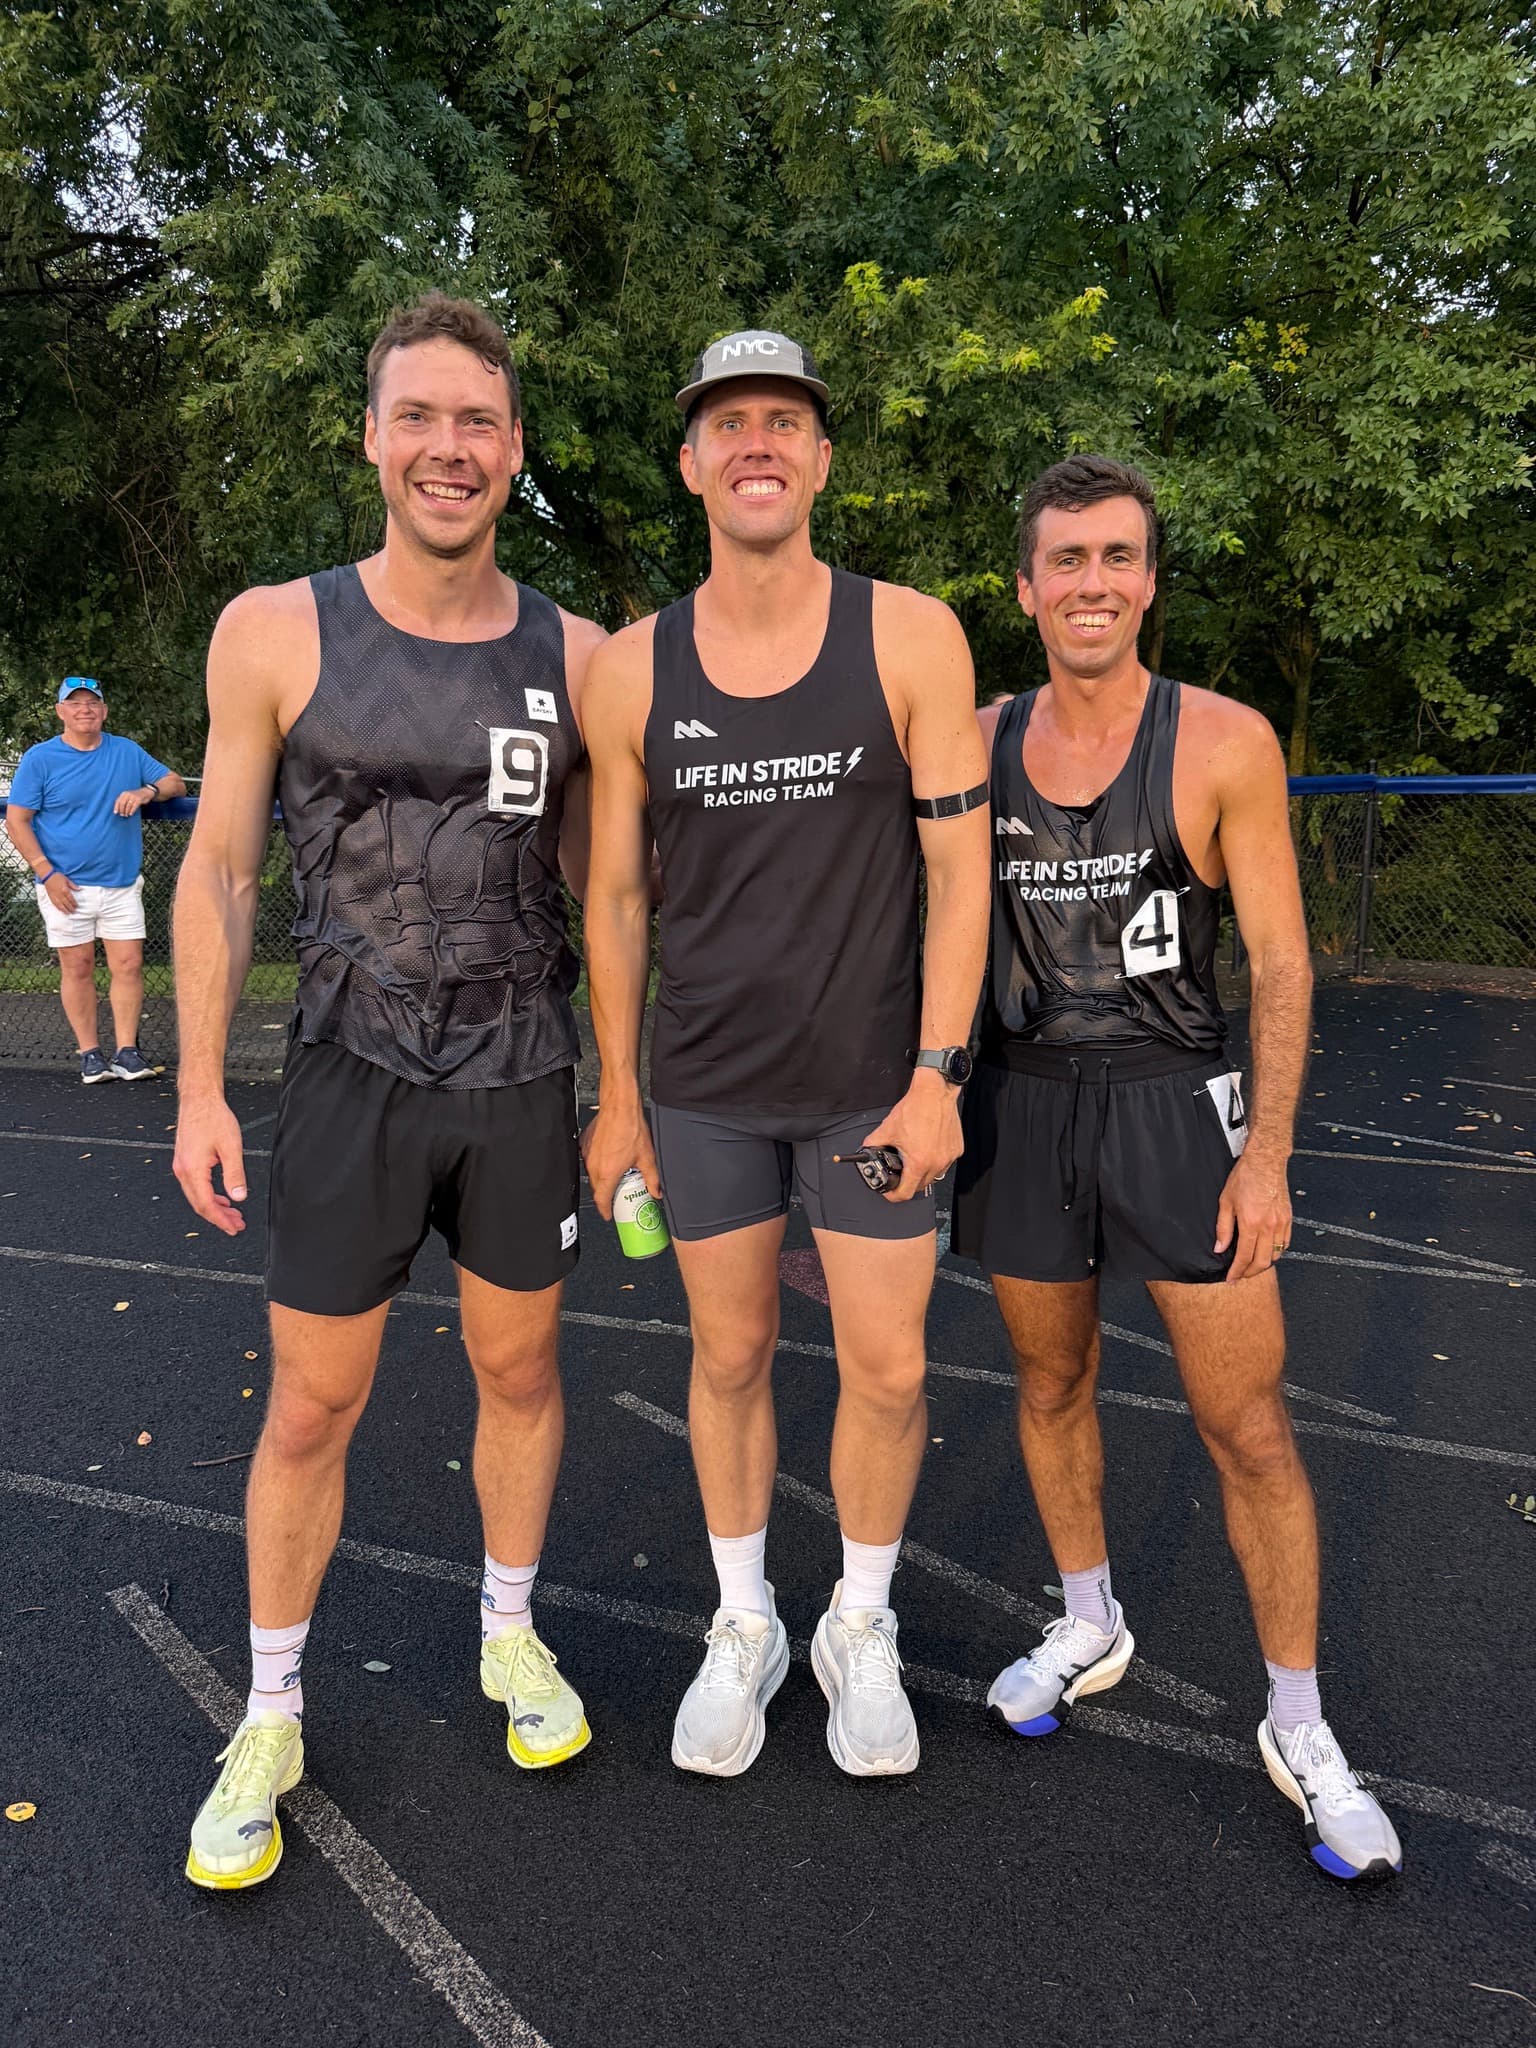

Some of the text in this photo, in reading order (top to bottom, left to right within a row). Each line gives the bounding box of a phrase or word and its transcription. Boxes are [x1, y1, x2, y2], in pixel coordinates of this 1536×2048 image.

[722, 339, 779, 362] NYC
[502, 736, 543, 808] 9
[675, 751, 842, 790] LIFE IN STRIDE
[703, 781, 835, 808] RACING TEAM
[999, 852, 1137, 882] LIFE IN STRIDE
[1020, 881, 1131, 902] RACING TEAM
[1128, 895, 1174, 958] 4
